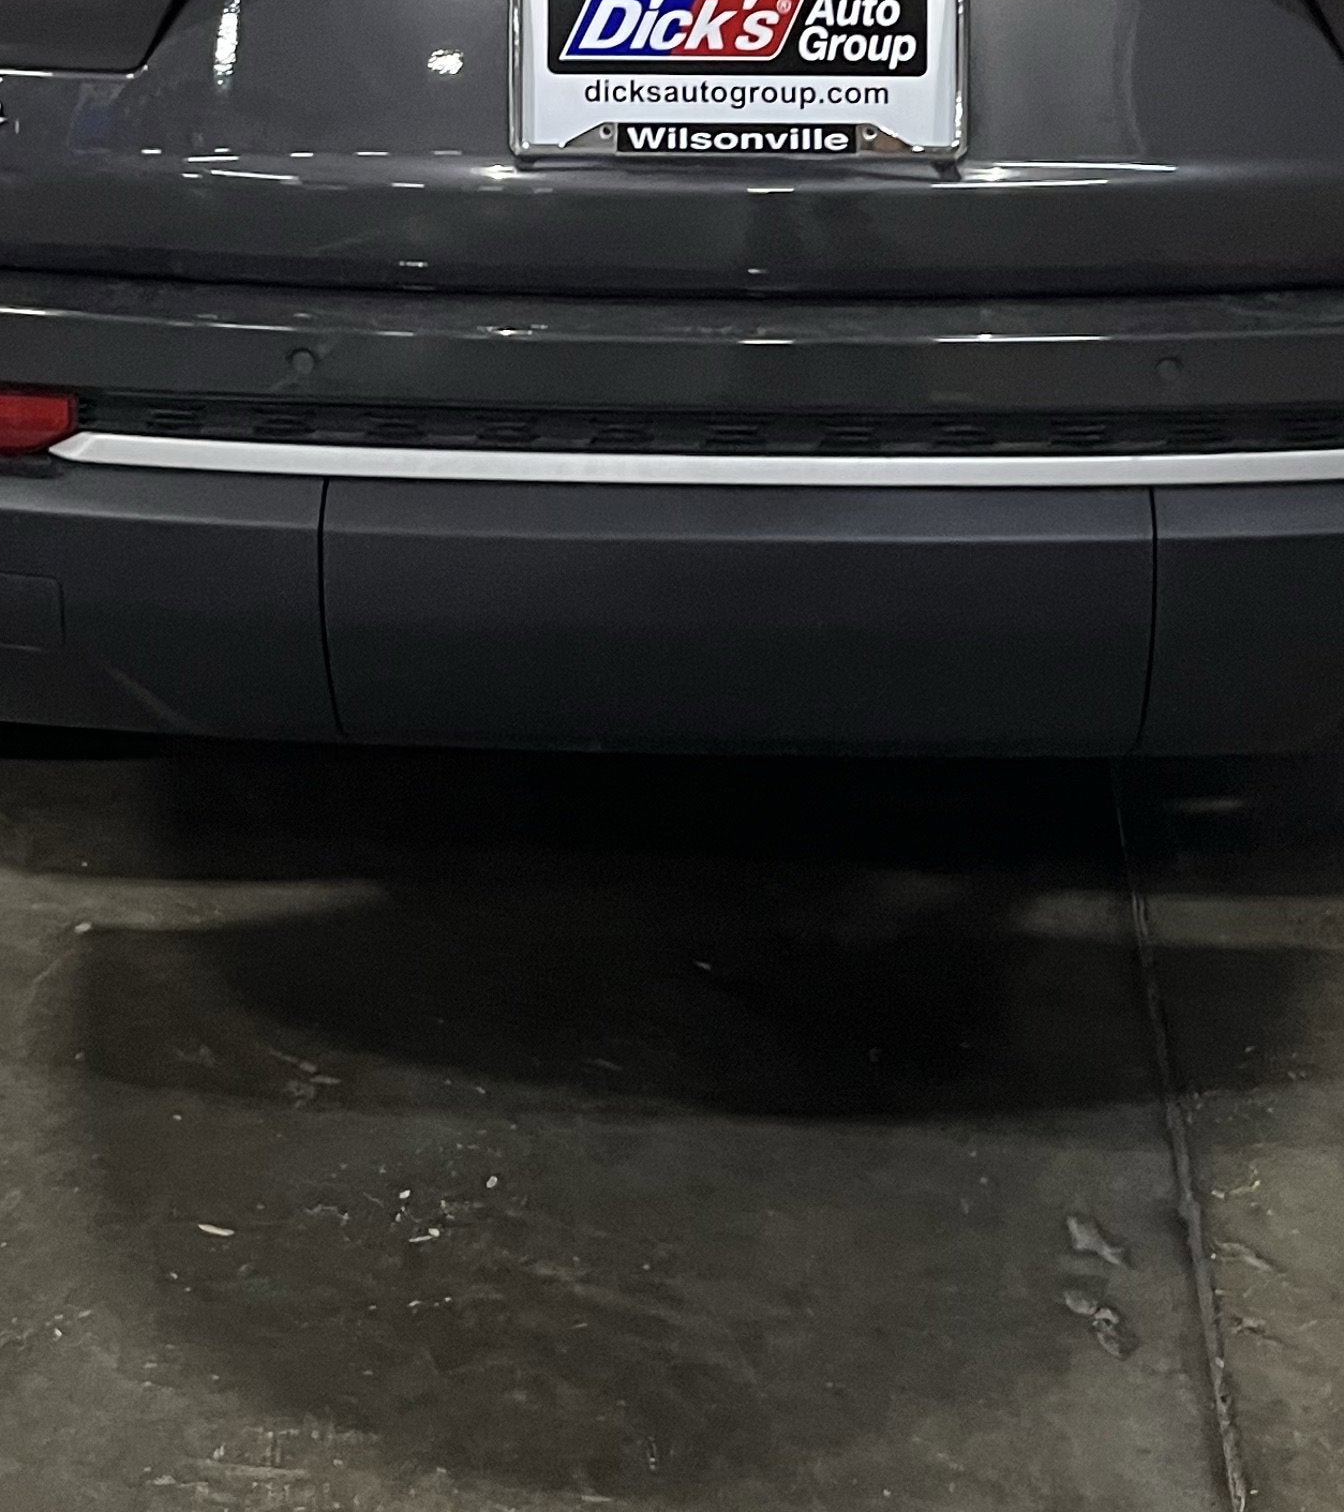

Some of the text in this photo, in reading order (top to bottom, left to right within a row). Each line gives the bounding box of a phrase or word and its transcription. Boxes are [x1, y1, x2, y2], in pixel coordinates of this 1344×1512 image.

[798, 27, 917, 70] Group
[584, 80, 890, 110] dicksautogroup.com
[626, 125, 849, 152] Wilsonville
